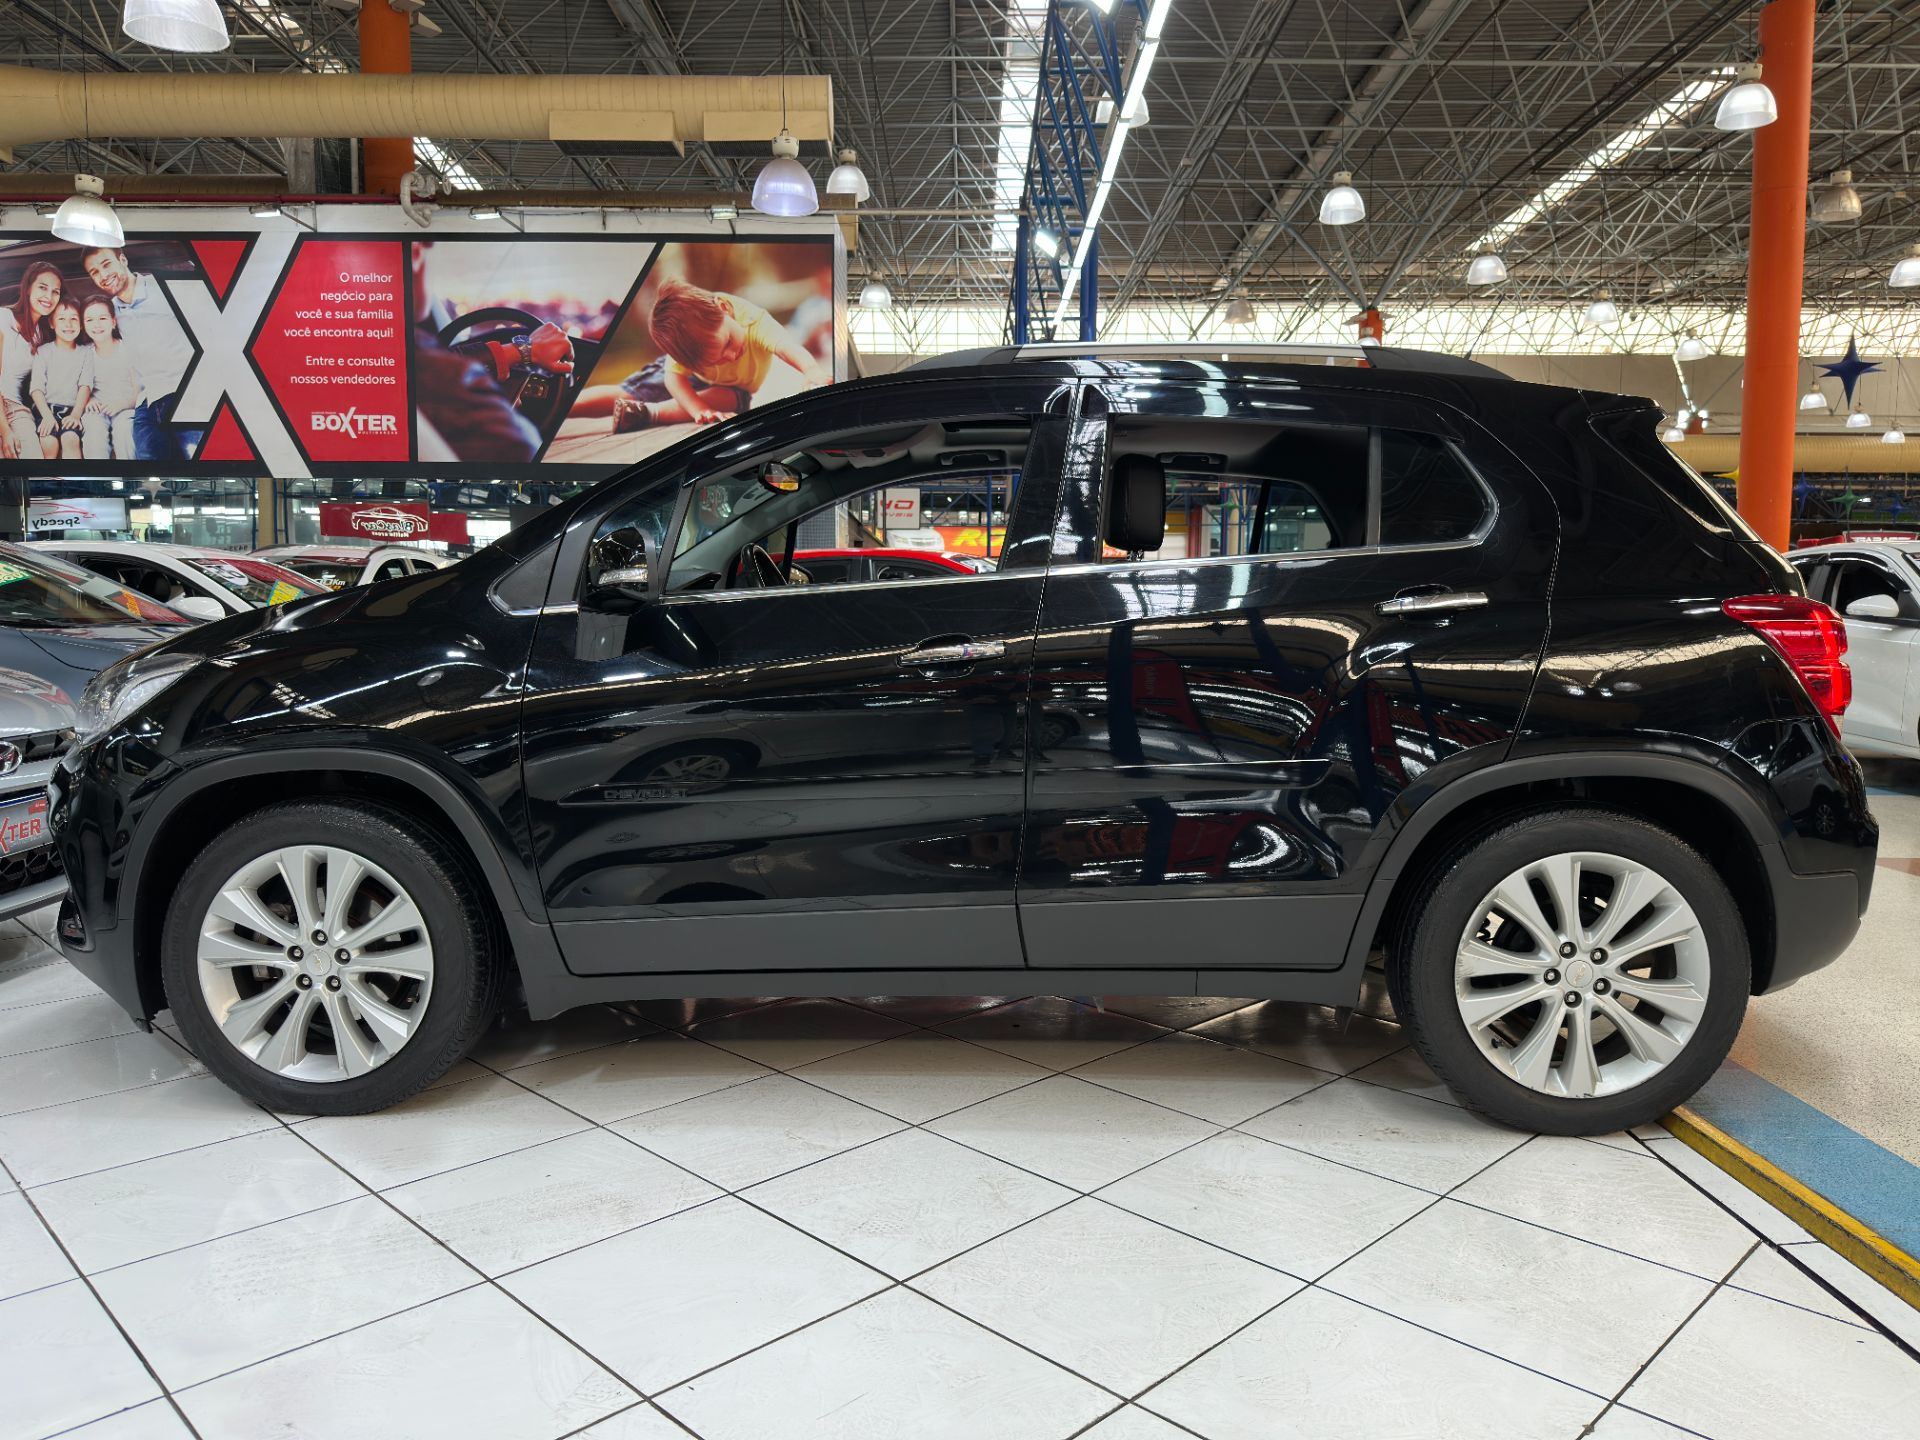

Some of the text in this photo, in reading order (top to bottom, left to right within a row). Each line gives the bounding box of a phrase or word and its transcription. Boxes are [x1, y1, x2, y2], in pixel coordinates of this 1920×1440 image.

[339, 272, 393, 283] O melhor
[320, 291, 393, 303] negócio para
[295, 308, 394, 319] você e sua família
[284, 326, 394, 340] você encontra aqui!
[305, 355, 396, 367] Entre e consulte
[290, 374, 396, 385] nossos vendedores
[311, 406, 397, 439] BOXTER
